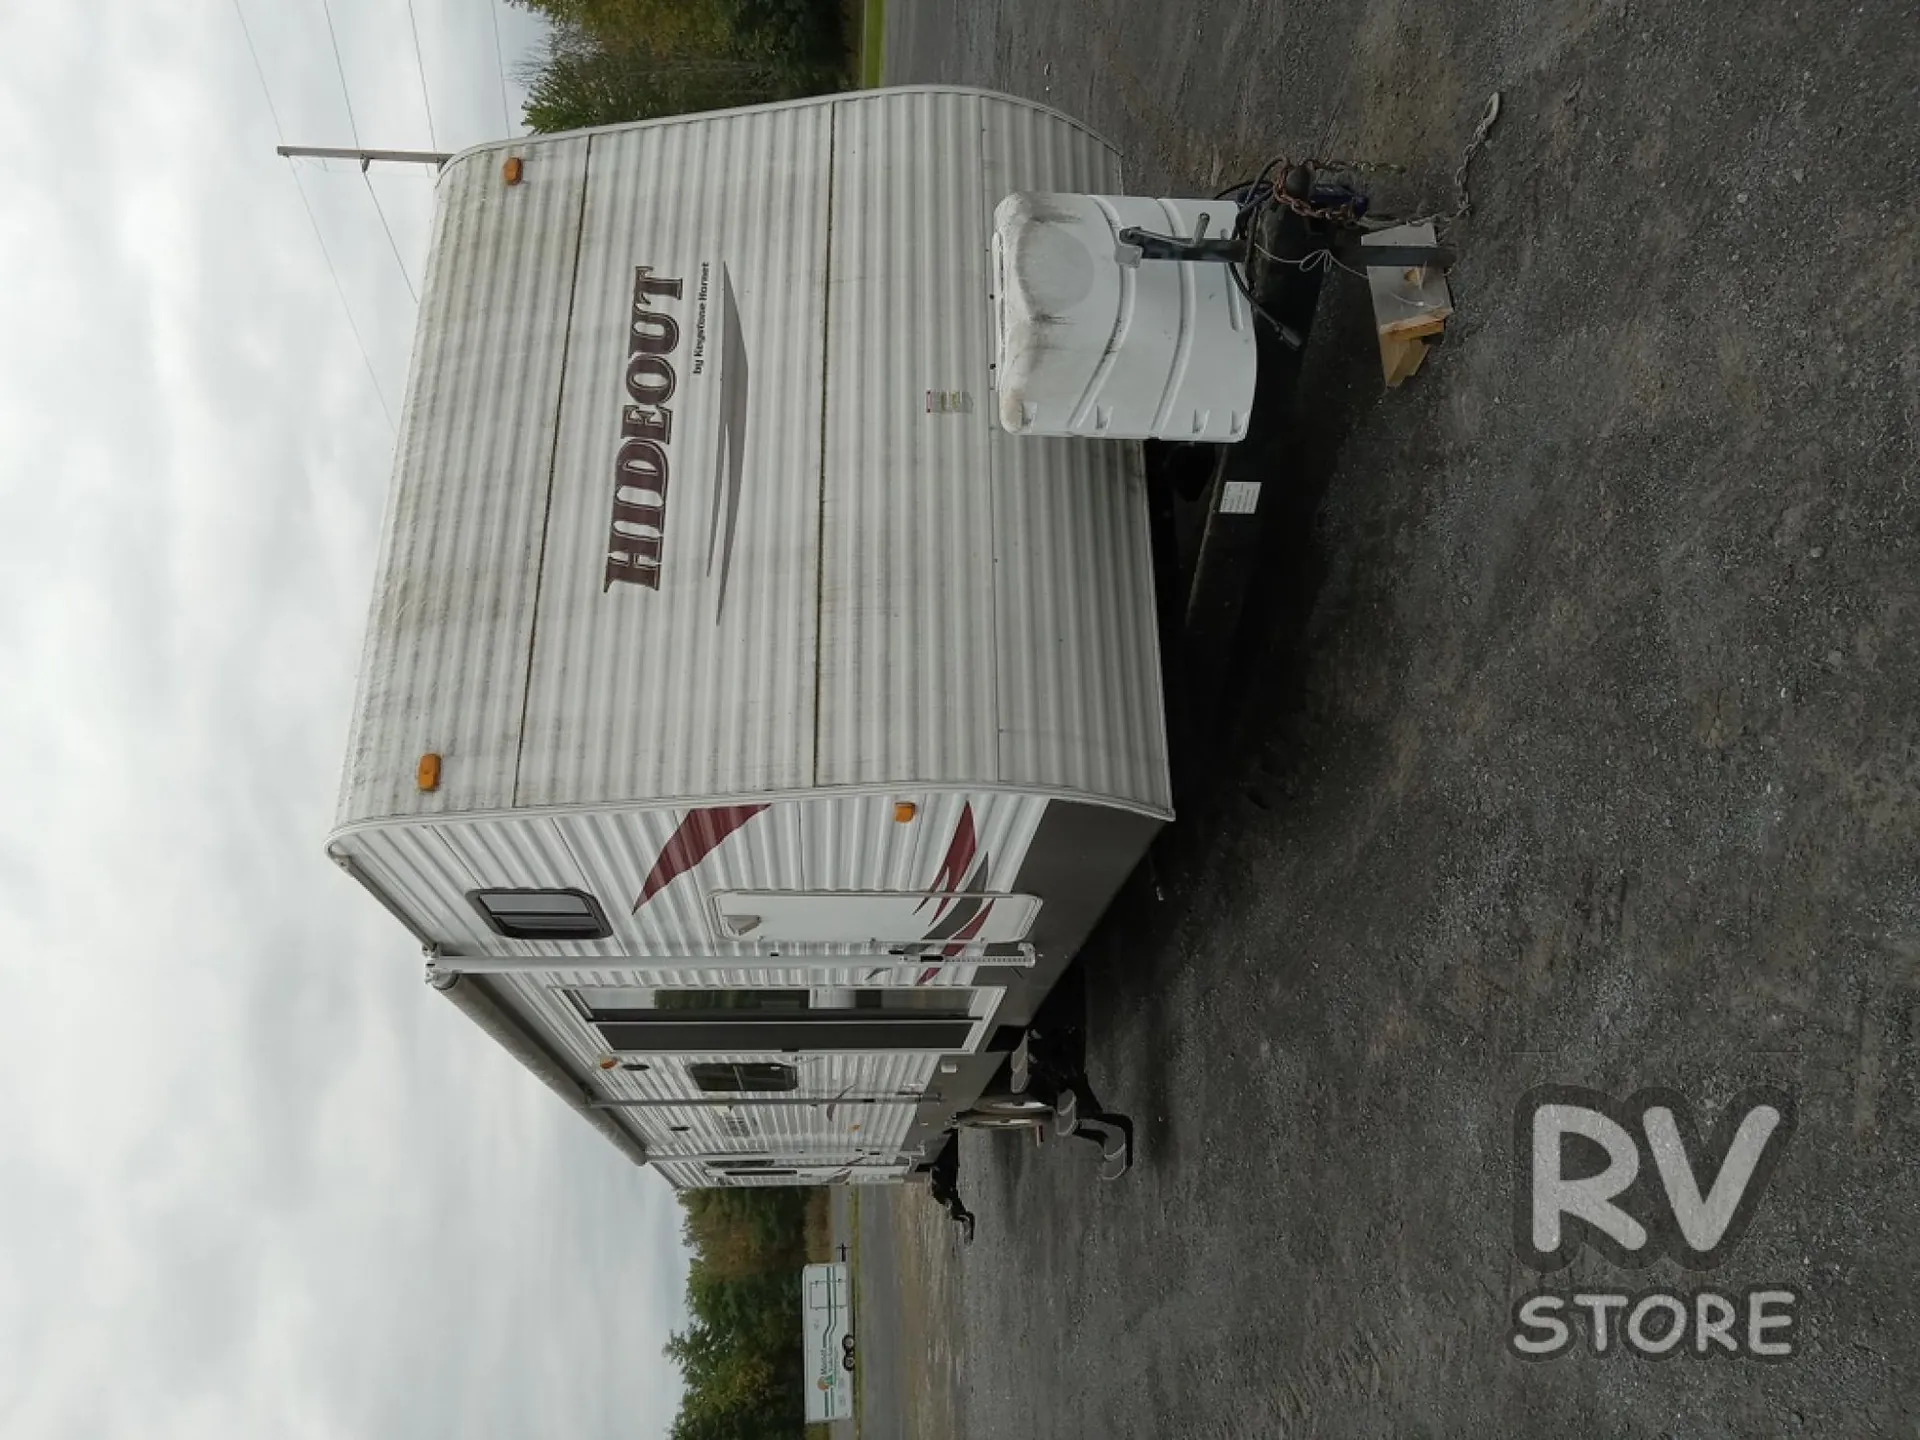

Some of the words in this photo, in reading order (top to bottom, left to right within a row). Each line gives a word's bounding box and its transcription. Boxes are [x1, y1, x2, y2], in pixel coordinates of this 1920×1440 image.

[697, 262, 709, 301] Hornet
[693, 302, 706, 357] Keystone
[692, 359, 704, 374] by
[604, 266, 683, 593] HIDEOUT
